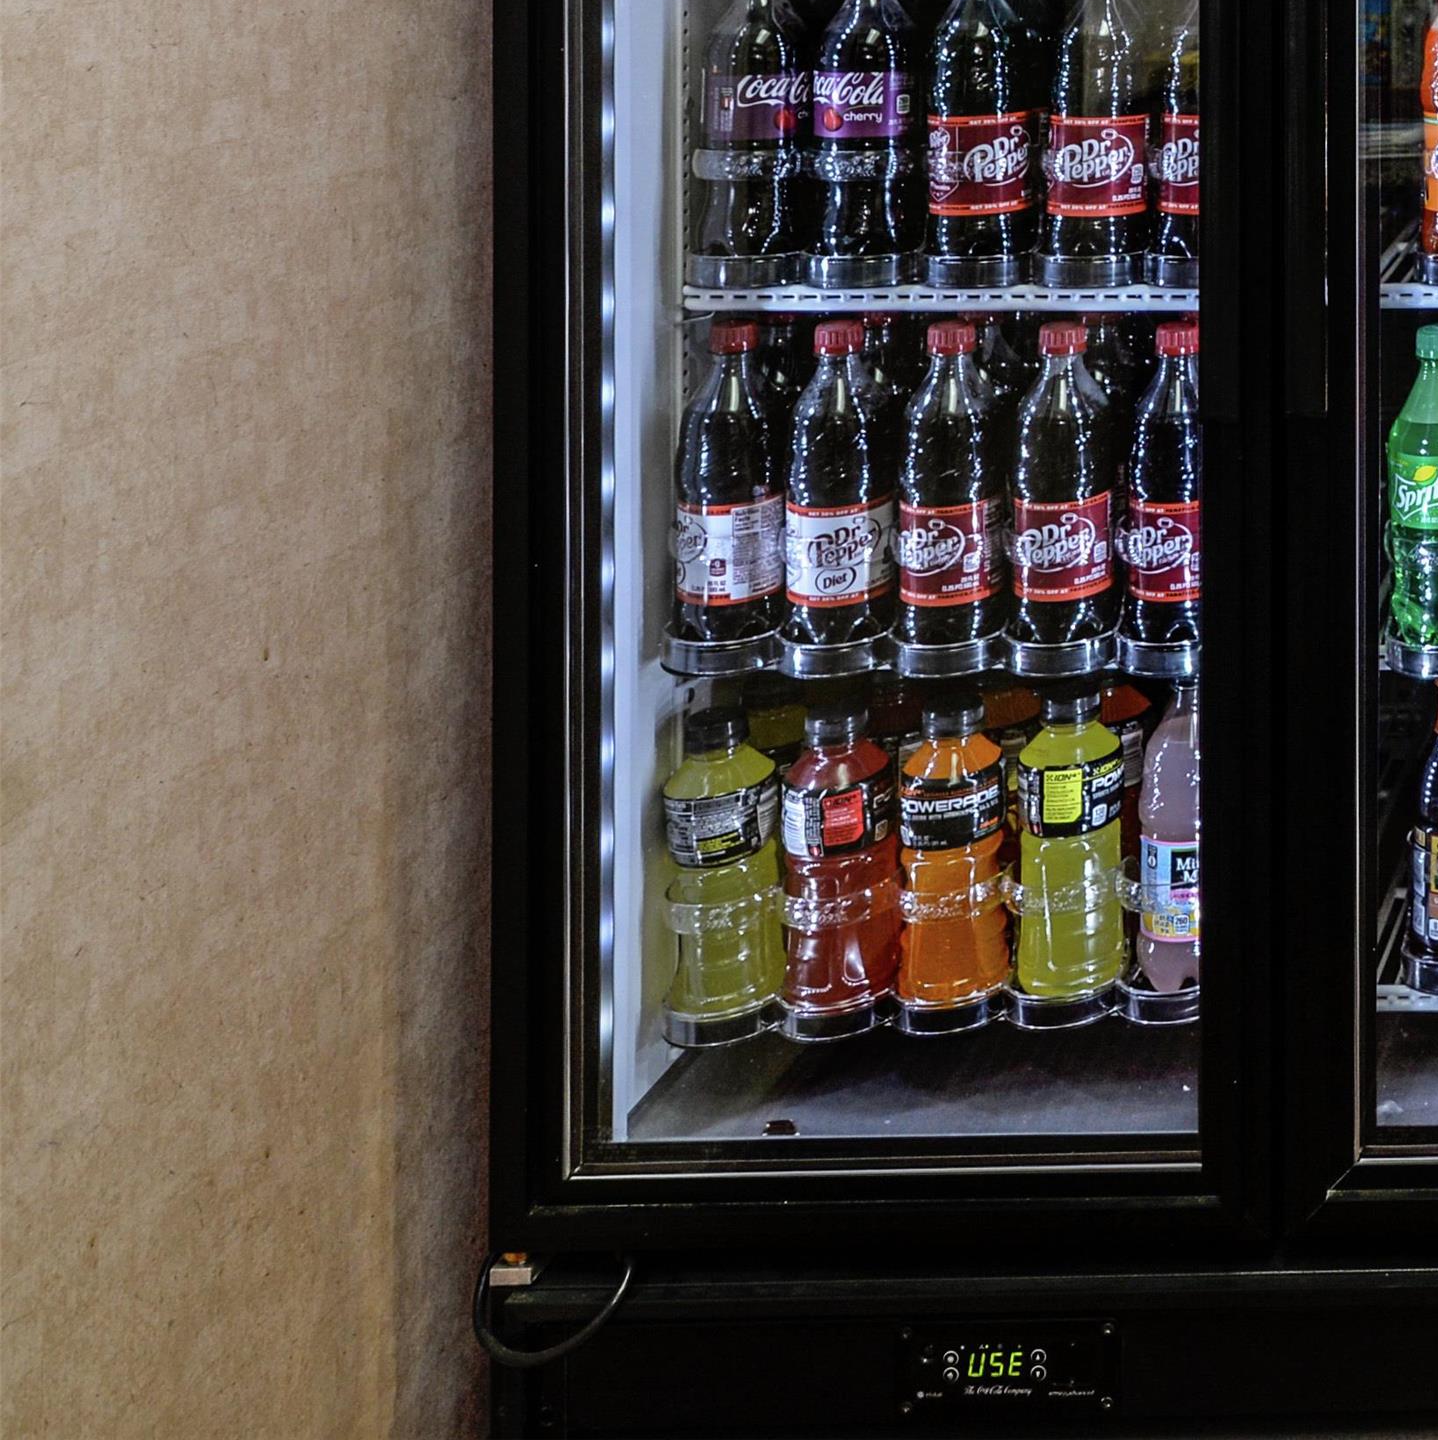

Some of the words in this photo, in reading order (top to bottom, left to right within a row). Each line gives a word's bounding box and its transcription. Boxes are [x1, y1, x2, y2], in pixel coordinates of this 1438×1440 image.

[844, 112, 882, 124] cherry
[994, 136, 1020, 159] Dr
[1082, 138, 1111, 160] Dr
[966, 143, 1029, 182] Pepper
[1058, 145, 1130, 182] Pepper
[834, 526, 861, 546] Dr
[1042, 524, 1072, 544] Dr
[823, 572, 848, 590] Diet
[967, 1352, 1023, 1377] USE
